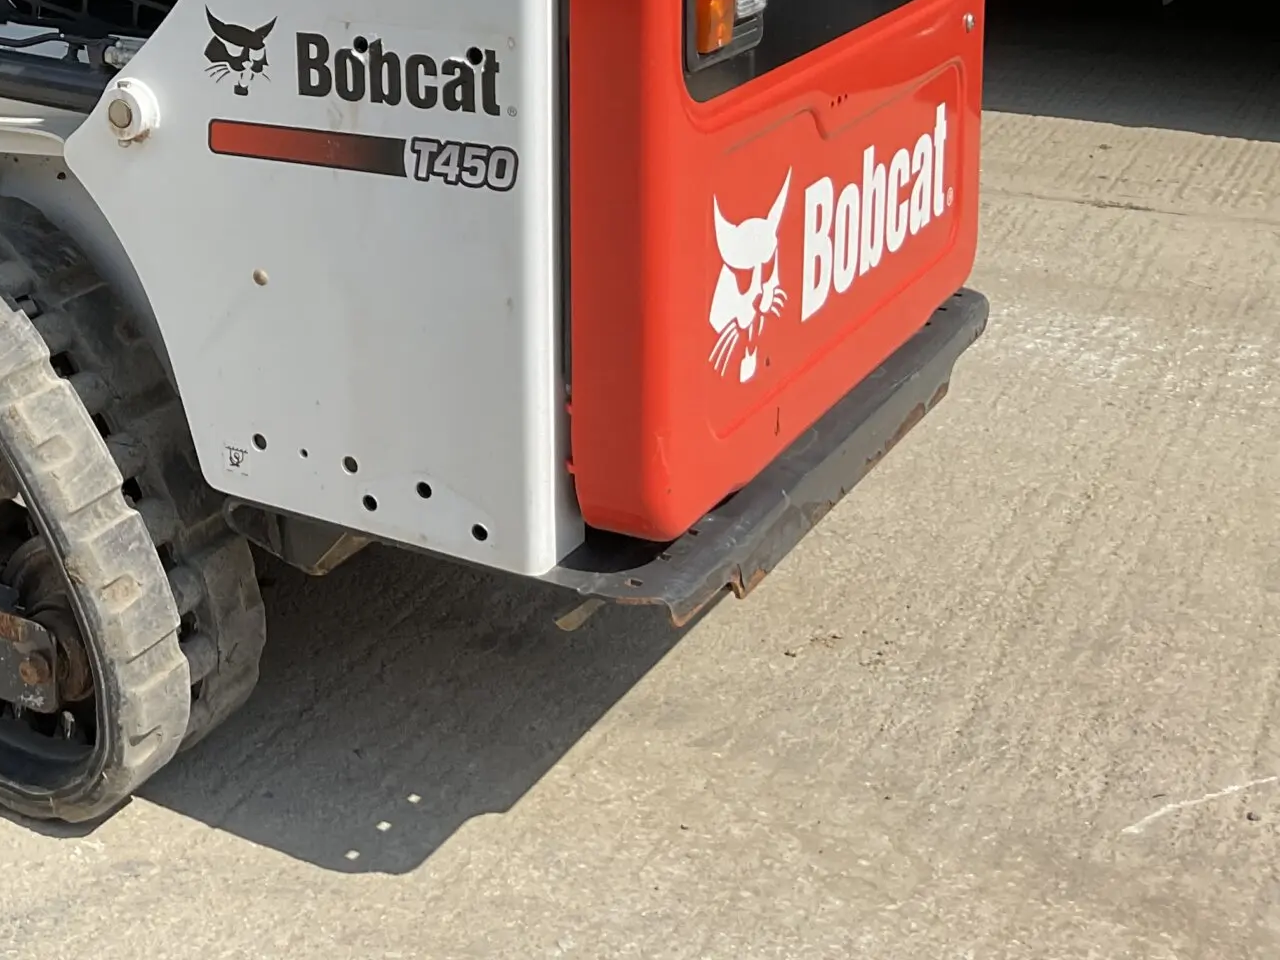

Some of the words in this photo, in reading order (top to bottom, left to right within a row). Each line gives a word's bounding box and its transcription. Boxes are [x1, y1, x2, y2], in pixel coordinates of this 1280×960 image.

[296, 31, 500, 117] Bobcat
[410, 136, 519, 192] T450
[801, 101, 947, 323] Bobcat
